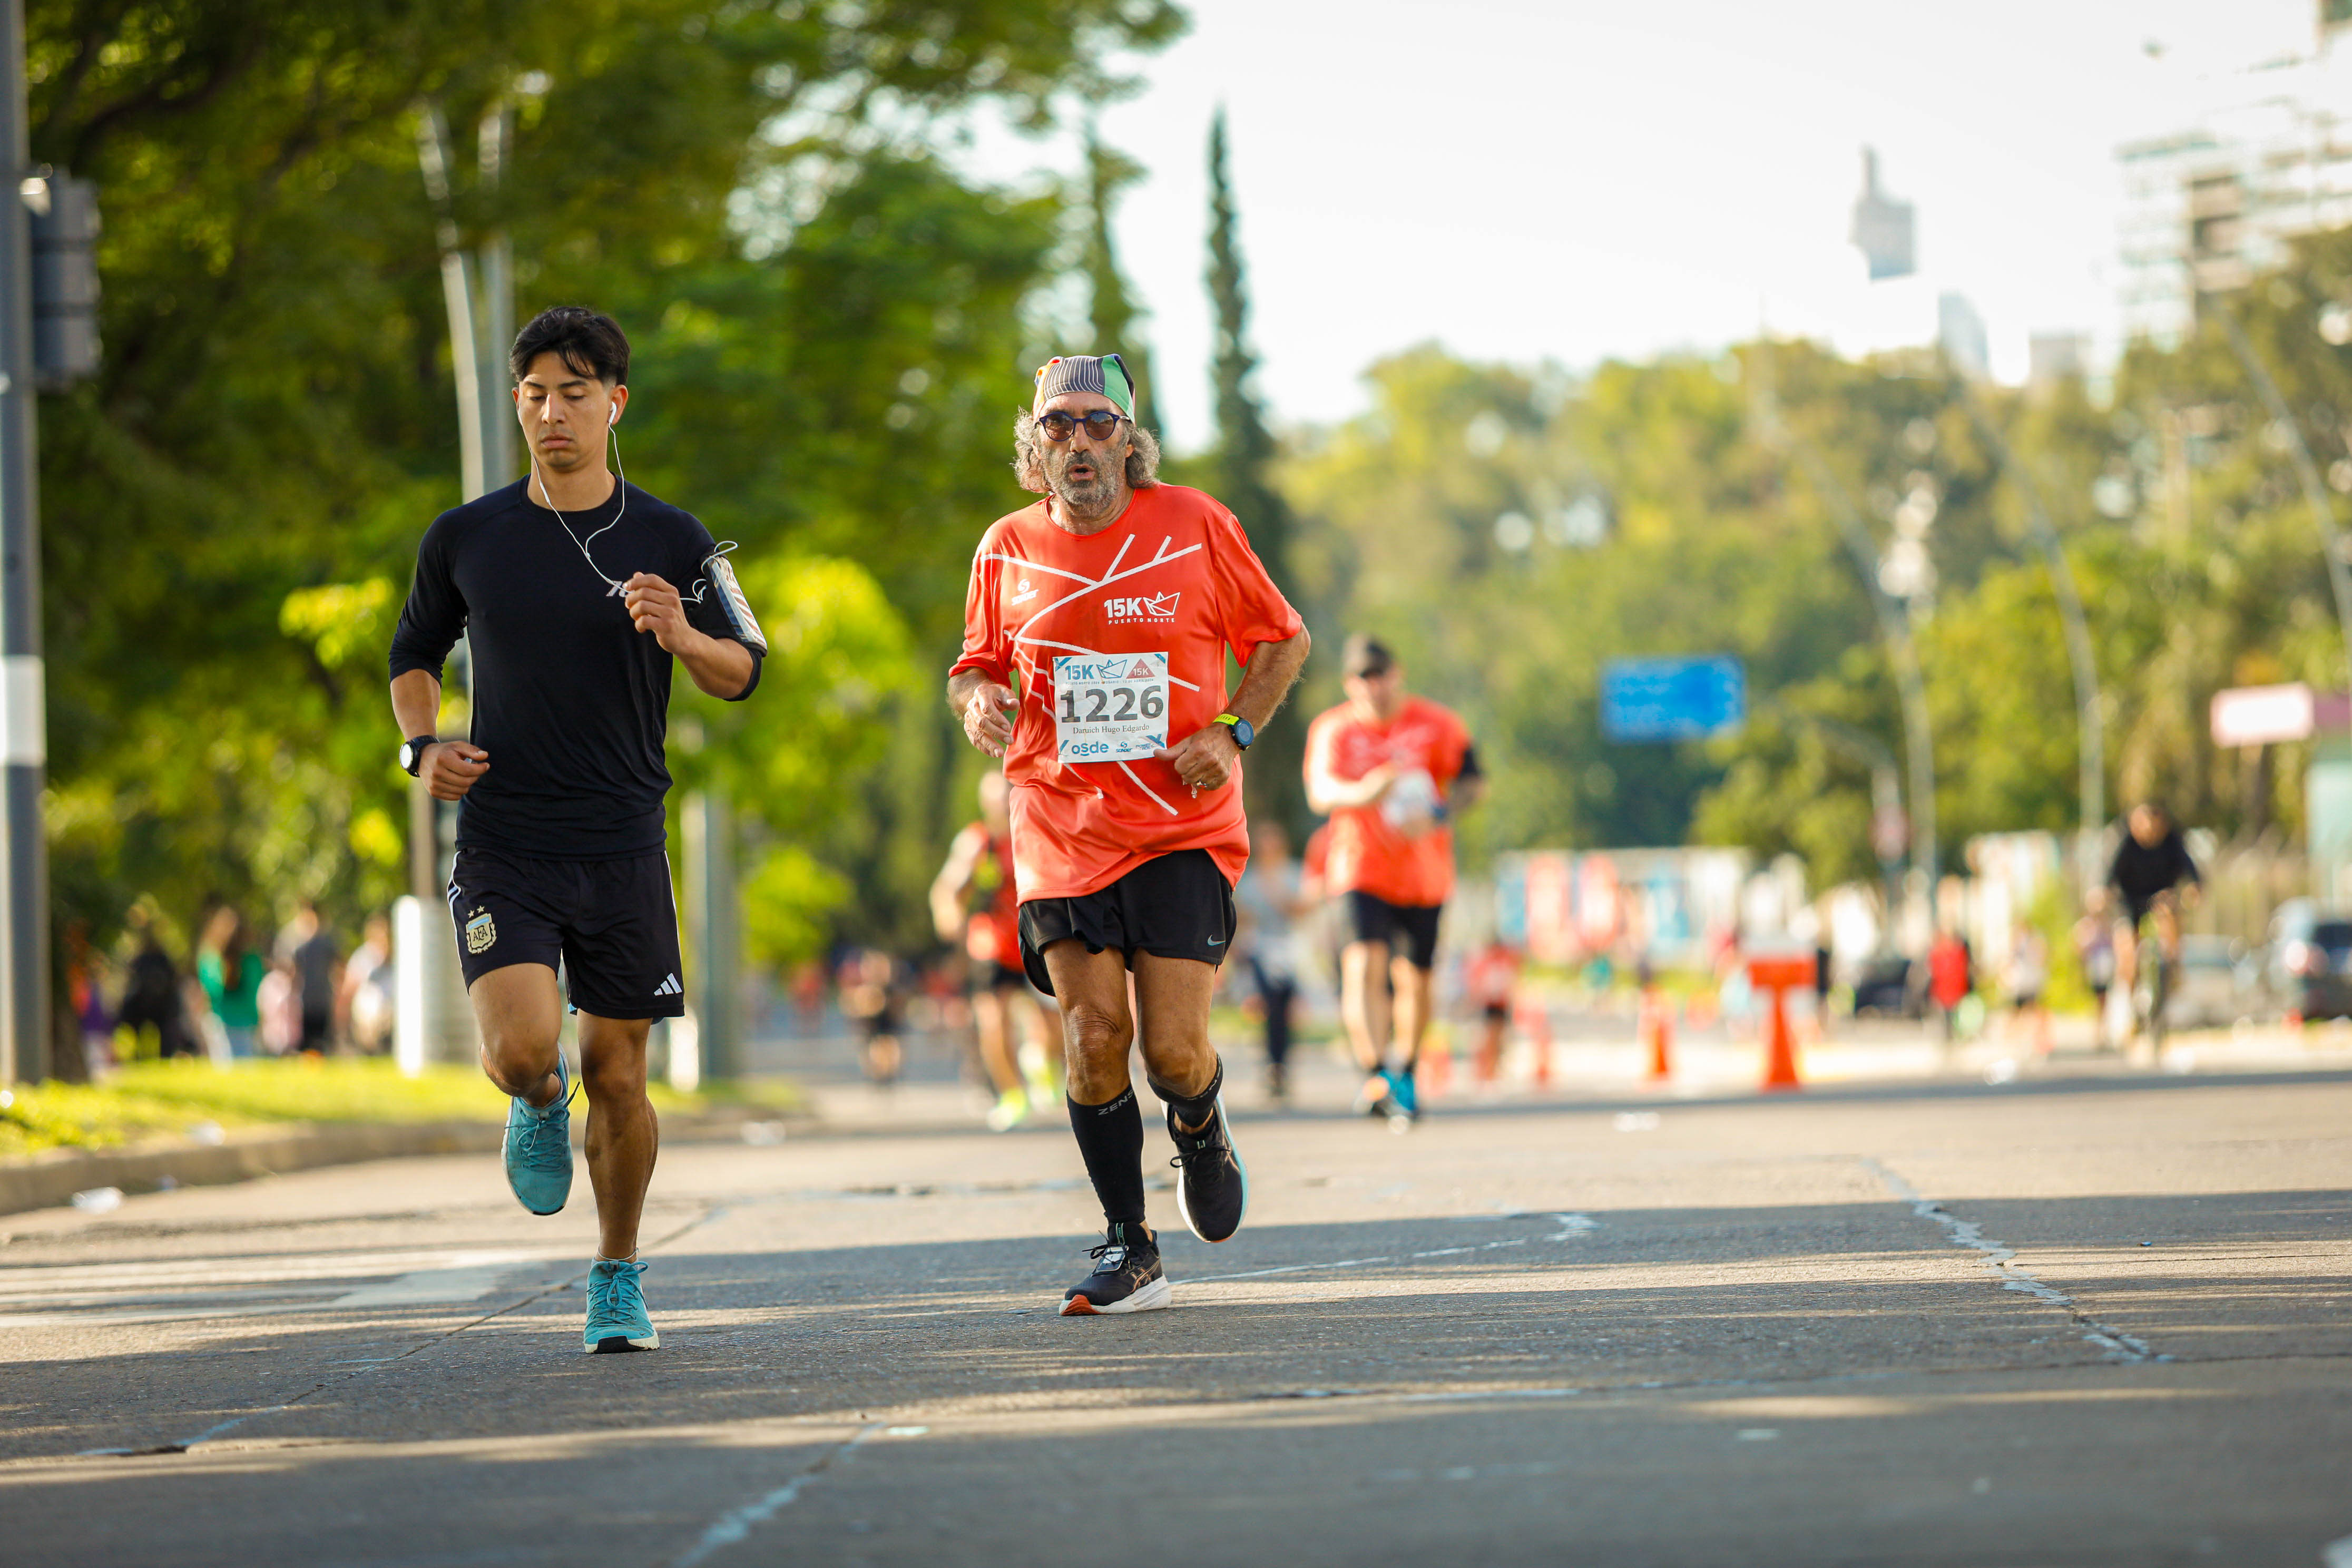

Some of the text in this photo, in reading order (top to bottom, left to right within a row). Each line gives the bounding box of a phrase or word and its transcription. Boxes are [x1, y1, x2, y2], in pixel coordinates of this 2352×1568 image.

[1104, 597, 1143, 618] 15K
[1065, 664, 1094, 680] 15K
[1060, 685, 1164, 723] 1226
[1102, 725, 1120, 734] Hugo
[1122, 723, 1150, 733] Edgardo
[1071, 741, 1109, 756] osde
[473, 925, 488, 942] AFA
